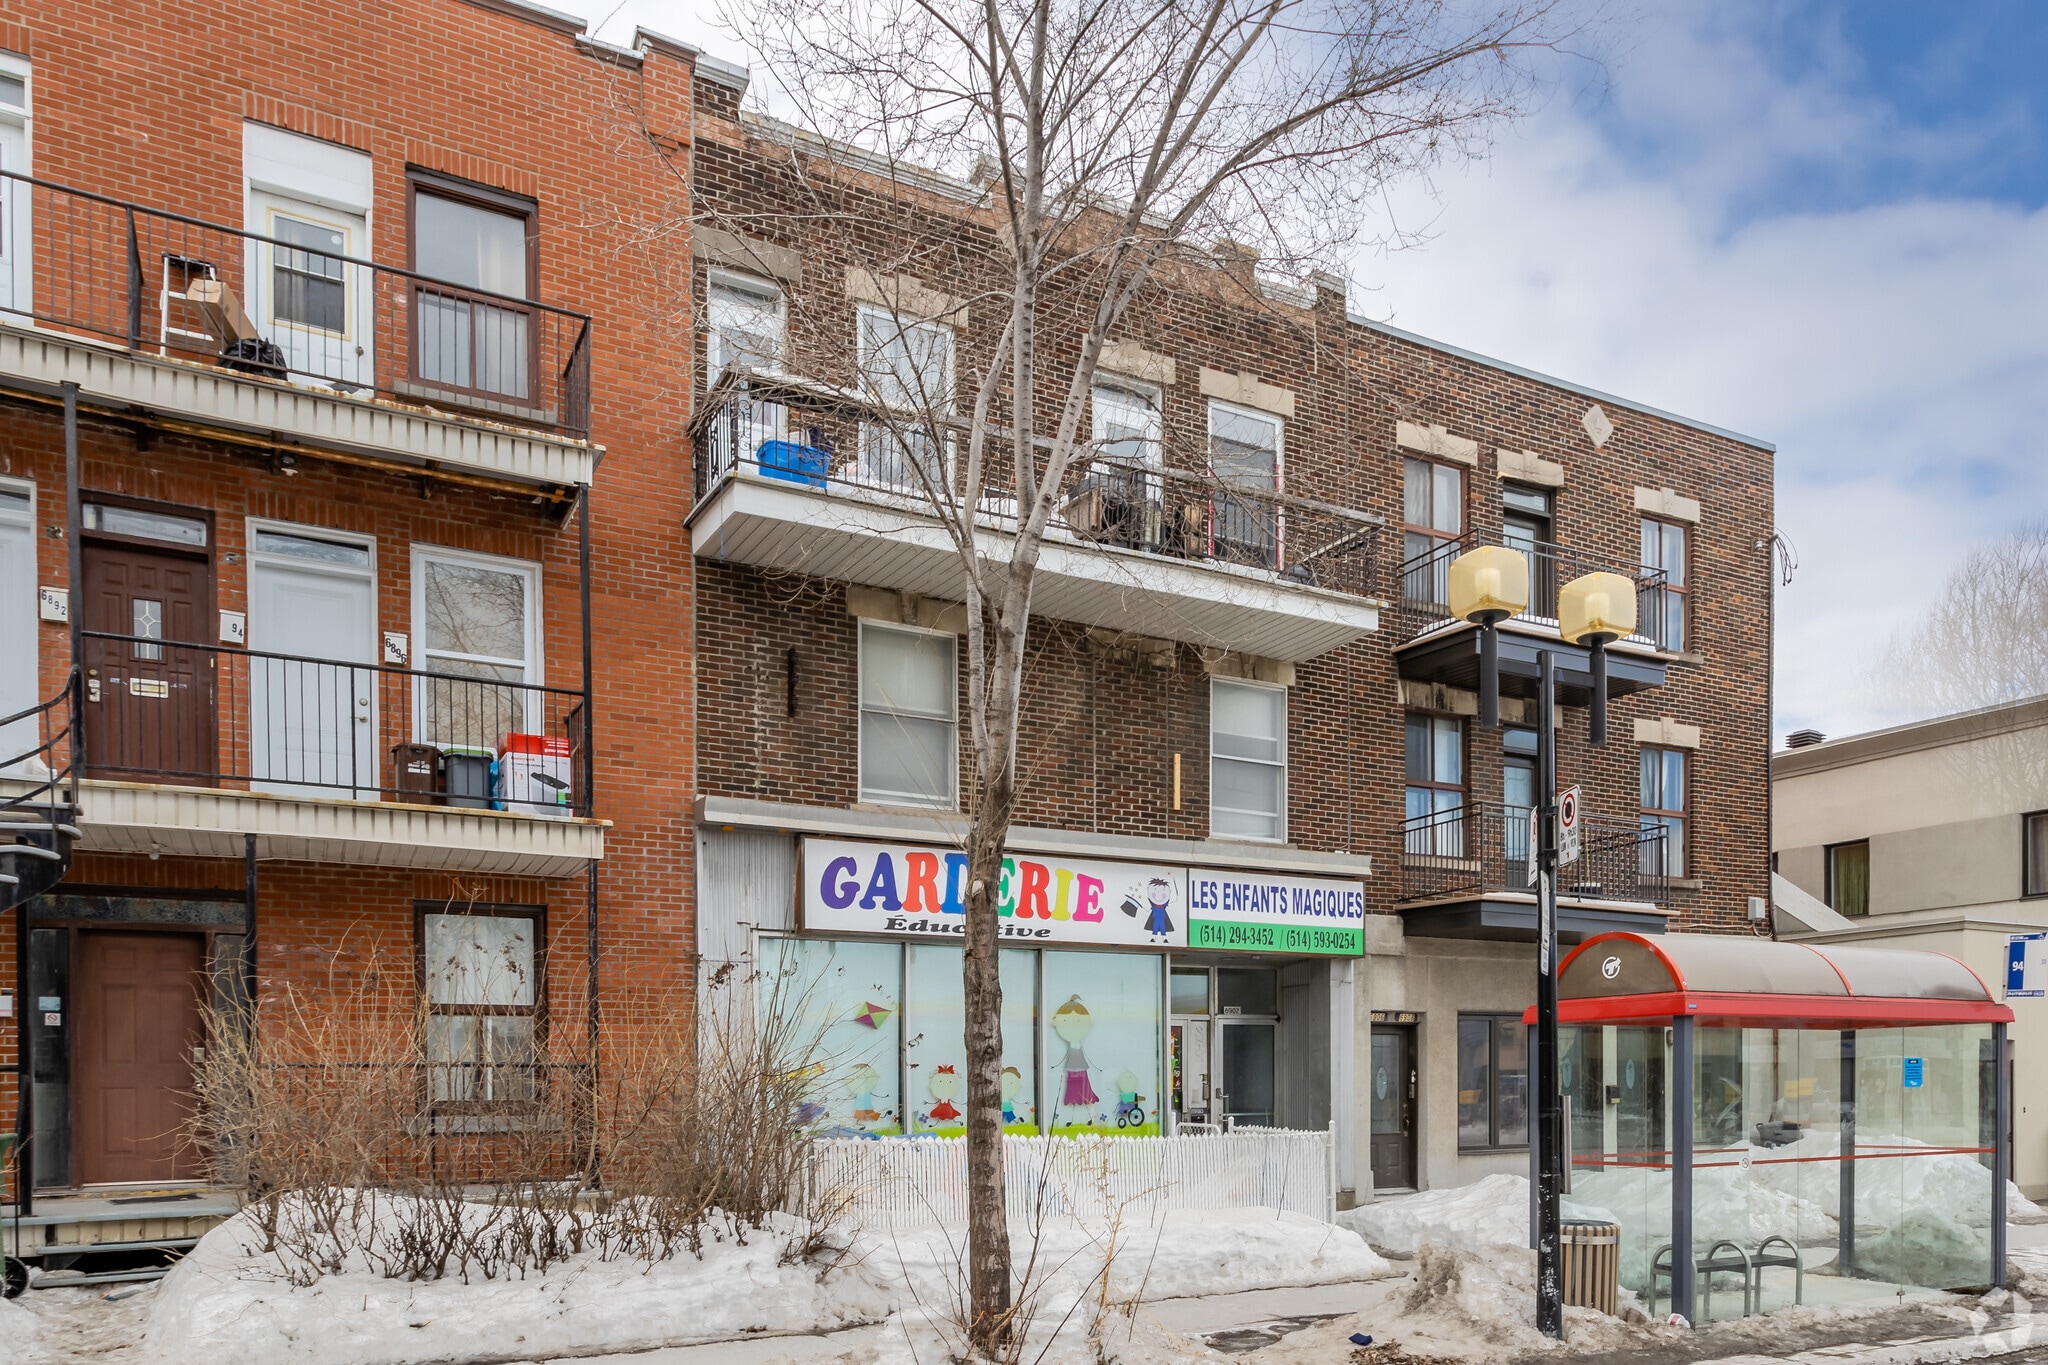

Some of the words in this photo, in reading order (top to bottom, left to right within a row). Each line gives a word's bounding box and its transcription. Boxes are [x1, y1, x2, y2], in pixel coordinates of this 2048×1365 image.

[41, 590, 67, 615] 6892
[231, 623, 244, 638] 94
[385, 637, 407, 664] 6896
[1192, 880, 1218, 910] LES
[1223, 882, 1288, 914] ENFANTS
[1292, 887, 1363, 920] MAGIQUES
[884, 914, 1051, 938] Éducive
[1199, 924, 1227, 947] (514)
[1229, 926, 1274, 946] 294-3452
[1286, 929, 1311, 951] (514)
[1313, 931, 1356, 950] 593-0254
[2012, 960, 2024, 972] 94
[1224, 1007, 1240, 1015] 6902
